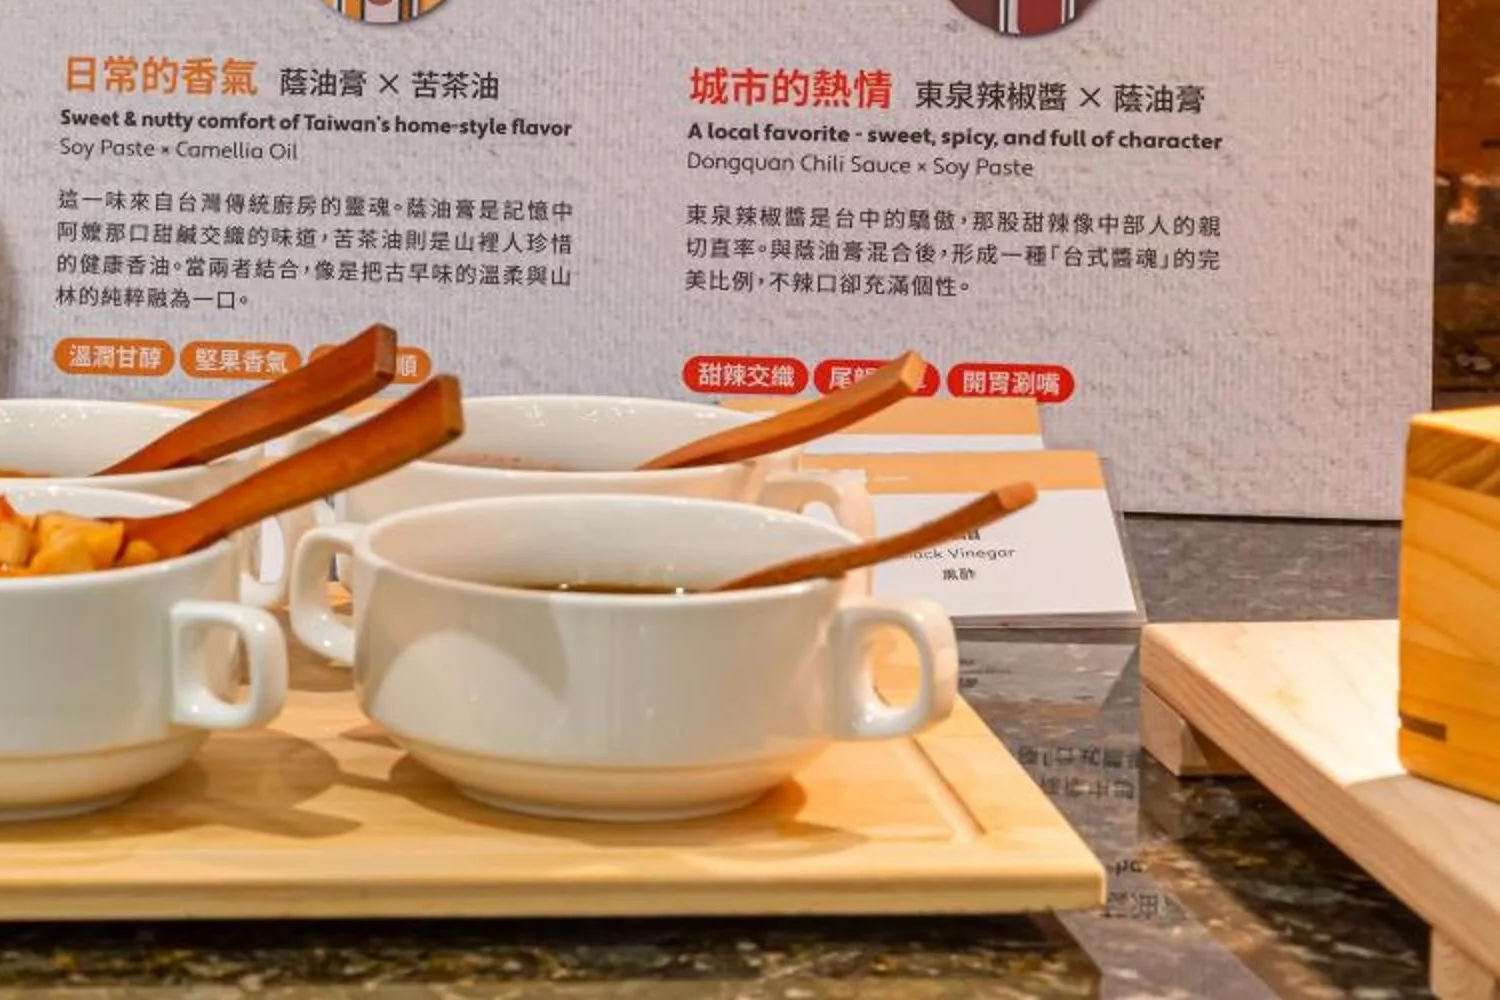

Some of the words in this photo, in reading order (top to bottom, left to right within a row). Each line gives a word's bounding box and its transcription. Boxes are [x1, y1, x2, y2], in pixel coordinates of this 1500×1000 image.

[66, 55, 259, 97] 日常的香氣
[280, 68, 367, 98] 蔭油膏
[411, 71, 500, 101] 苦茶油
[689, 66, 892, 109] 城市的熱情
[916, 80, 1068, 112] 東泉辣椒醬
[1113, 84, 1205, 115] 蔭油膏
[60, 109, 120, 127] Sweet
[123, 111, 137, 128] &
[141, 112, 194, 133] nutty
[197, 112, 275, 131] comfort
[279, 113, 301, 131] of
[303, 115, 391, 133] Taiwan's
[395, 116, 507, 139] home-style
[511, 118, 574, 137] flavor
[687, 123, 702, 140] A
[707, 122, 759, 141] local
[764, 123, 850, 142] favorite
[867, 127, 936, 147] sweet,
[941, 128, 998, 150] spicy,
[1003, 129, 1046, 147] and
[1049, 129, 1086, 148] full
[1091, 130, 1115, 148] of
[1118, 131, 1223, 150] character
[59, 138, 95, 161] Soy
[100, 139, 156, 157] Paste
[175, 141, 263, 160] Camellia
[269, 142, 298, 160] Oil
[687, 151, 795, 175] Dongquan
[800, 154, 844, 173] Chili
[851, 156, 911, 174] Sauce
[932, 157, 970, 180] Soy
[975, 158, 1034, 177] Paste
[67, 343, 163, 370] 溫潤甘醇
[698, 363, 796, 388] 甜辣交織
[962, 370, 1060, 396] 開胃涮嘴
[909, 548, 943, 560] lack
[948, 547, 1017, 561] Vinegar
